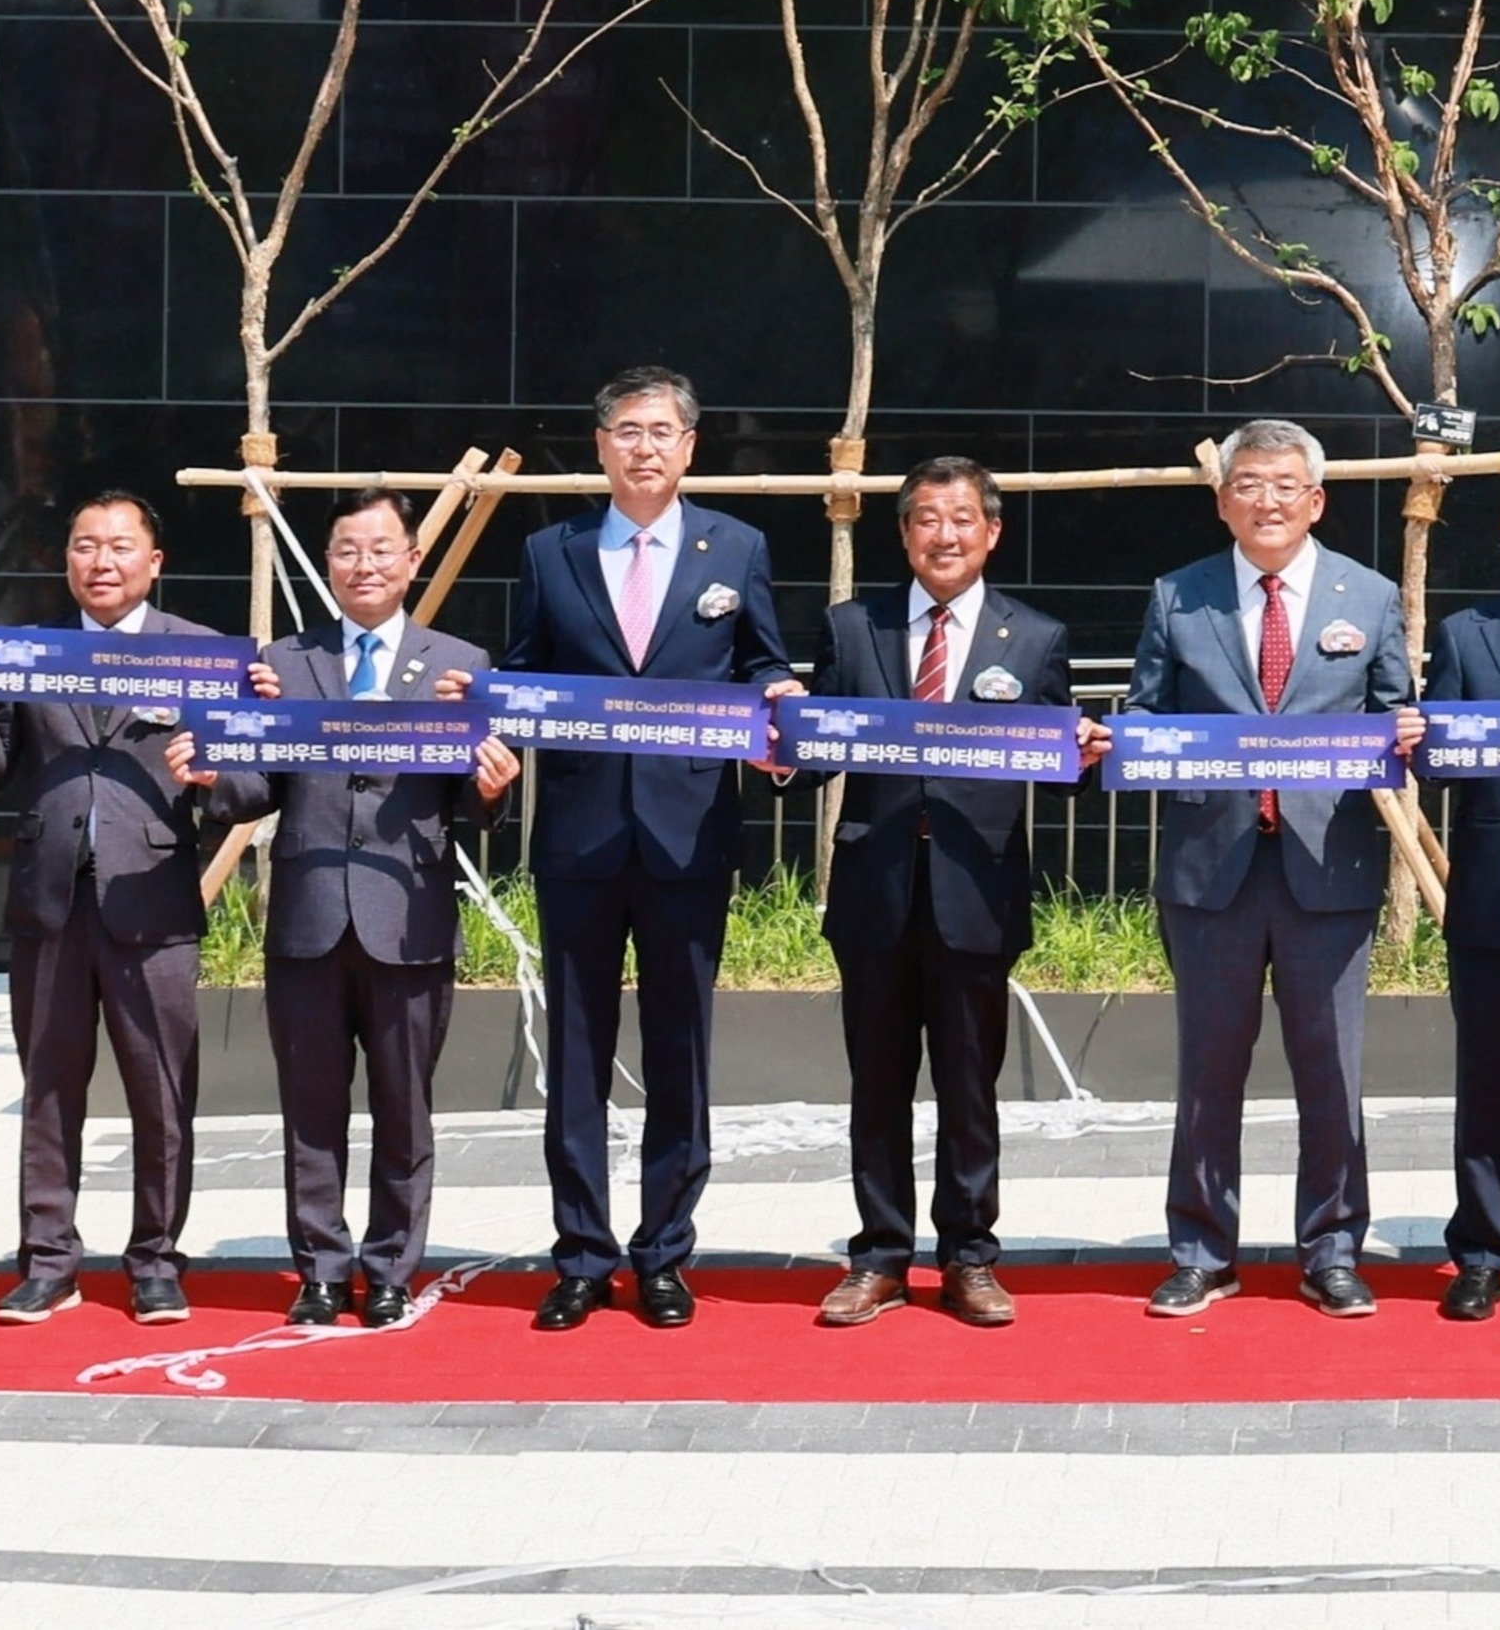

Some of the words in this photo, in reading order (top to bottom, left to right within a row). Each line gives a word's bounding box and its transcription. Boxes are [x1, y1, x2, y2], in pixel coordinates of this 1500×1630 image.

[29, 673, 96, 693] 클라우드
[100, 677, 182, 697] 데이터센터
[187, 680, 237, 699] 준공식
[206, 742, 255, 761] 경북형
[260, 743, 327, 761] 클라우드
[332, 744, 415, 762] 데이터센터
[419, 744, 470, 763] 준공식
[796, 741, 846, 761] 경북형
[850, 743, 918, 763] 클라우드
[923, 746, 1005, 768] 데이터센터
[1009, 750, 1061, 771] 준공식
[1428, 747, 1477, 767] 경북형
[1122, 760, 1172, 779] 경북형
[1176, 760, 1244, 779] 클라우드
[1248, 759, 1331, 778] 데이터센터
[1335, 759, 1384, 779] 준공식
